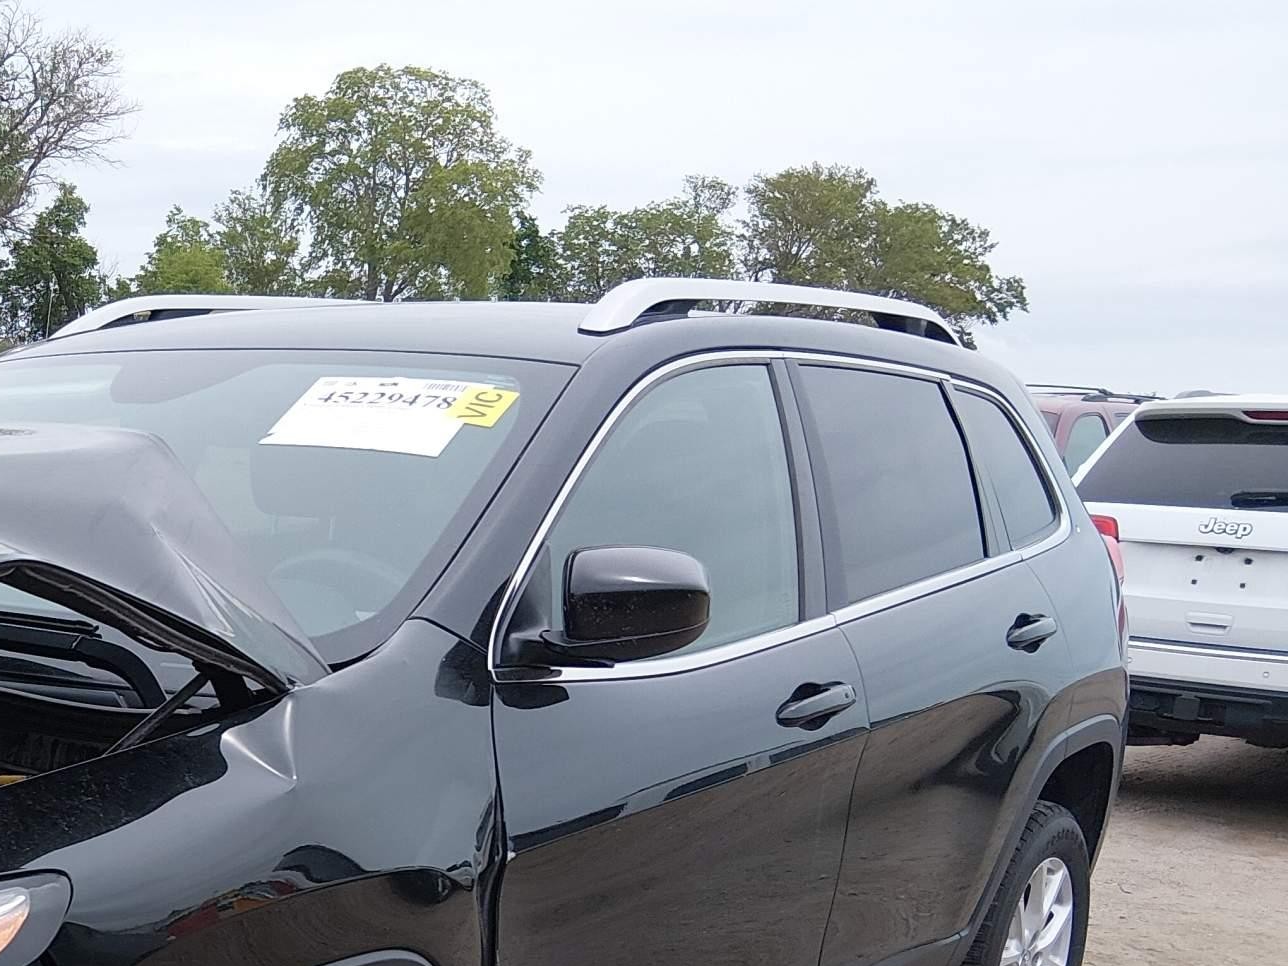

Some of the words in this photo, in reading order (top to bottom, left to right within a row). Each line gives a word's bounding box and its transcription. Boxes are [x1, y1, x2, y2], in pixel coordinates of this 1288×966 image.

[317, 390, 457, 410] 45229478
[456, 391, 504, 419] VIC
[1198, 517, 1253, 539] Jeep
